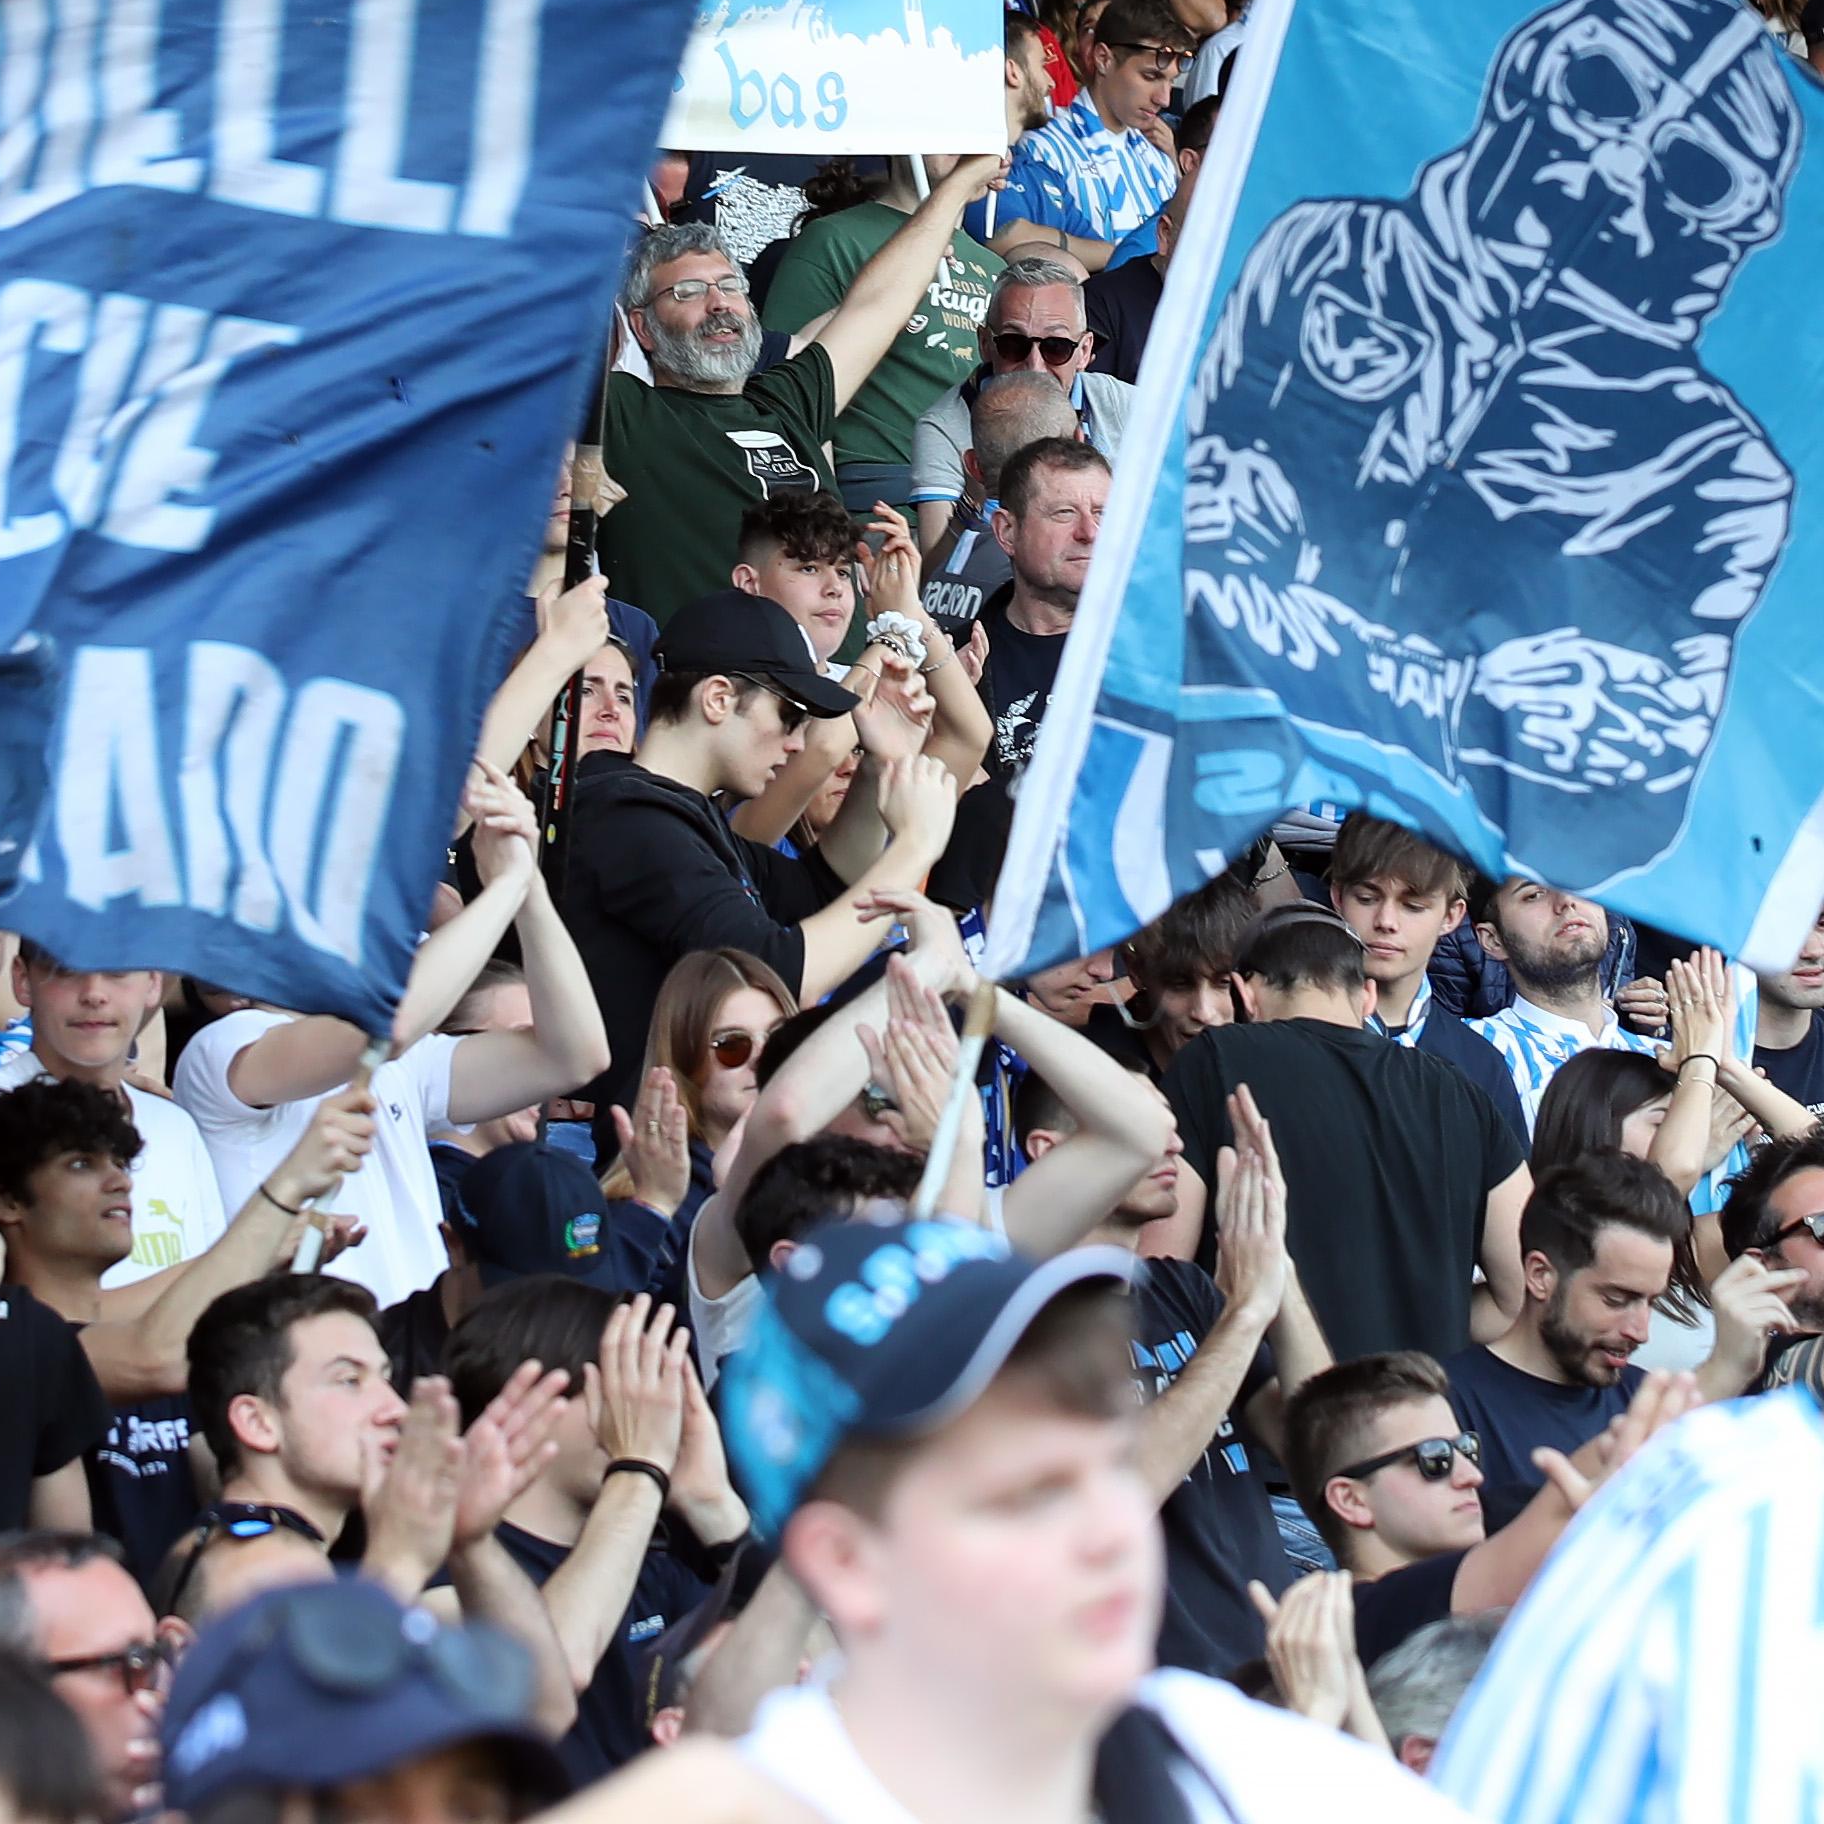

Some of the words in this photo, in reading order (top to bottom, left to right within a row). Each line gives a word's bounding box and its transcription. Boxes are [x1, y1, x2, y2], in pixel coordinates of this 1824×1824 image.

[714, 38, 848, 132] bas
[927, 282, 993, 323] Rug
[951, 278, 988, 296] 2015
[941, 310, 989, 333] WORL
